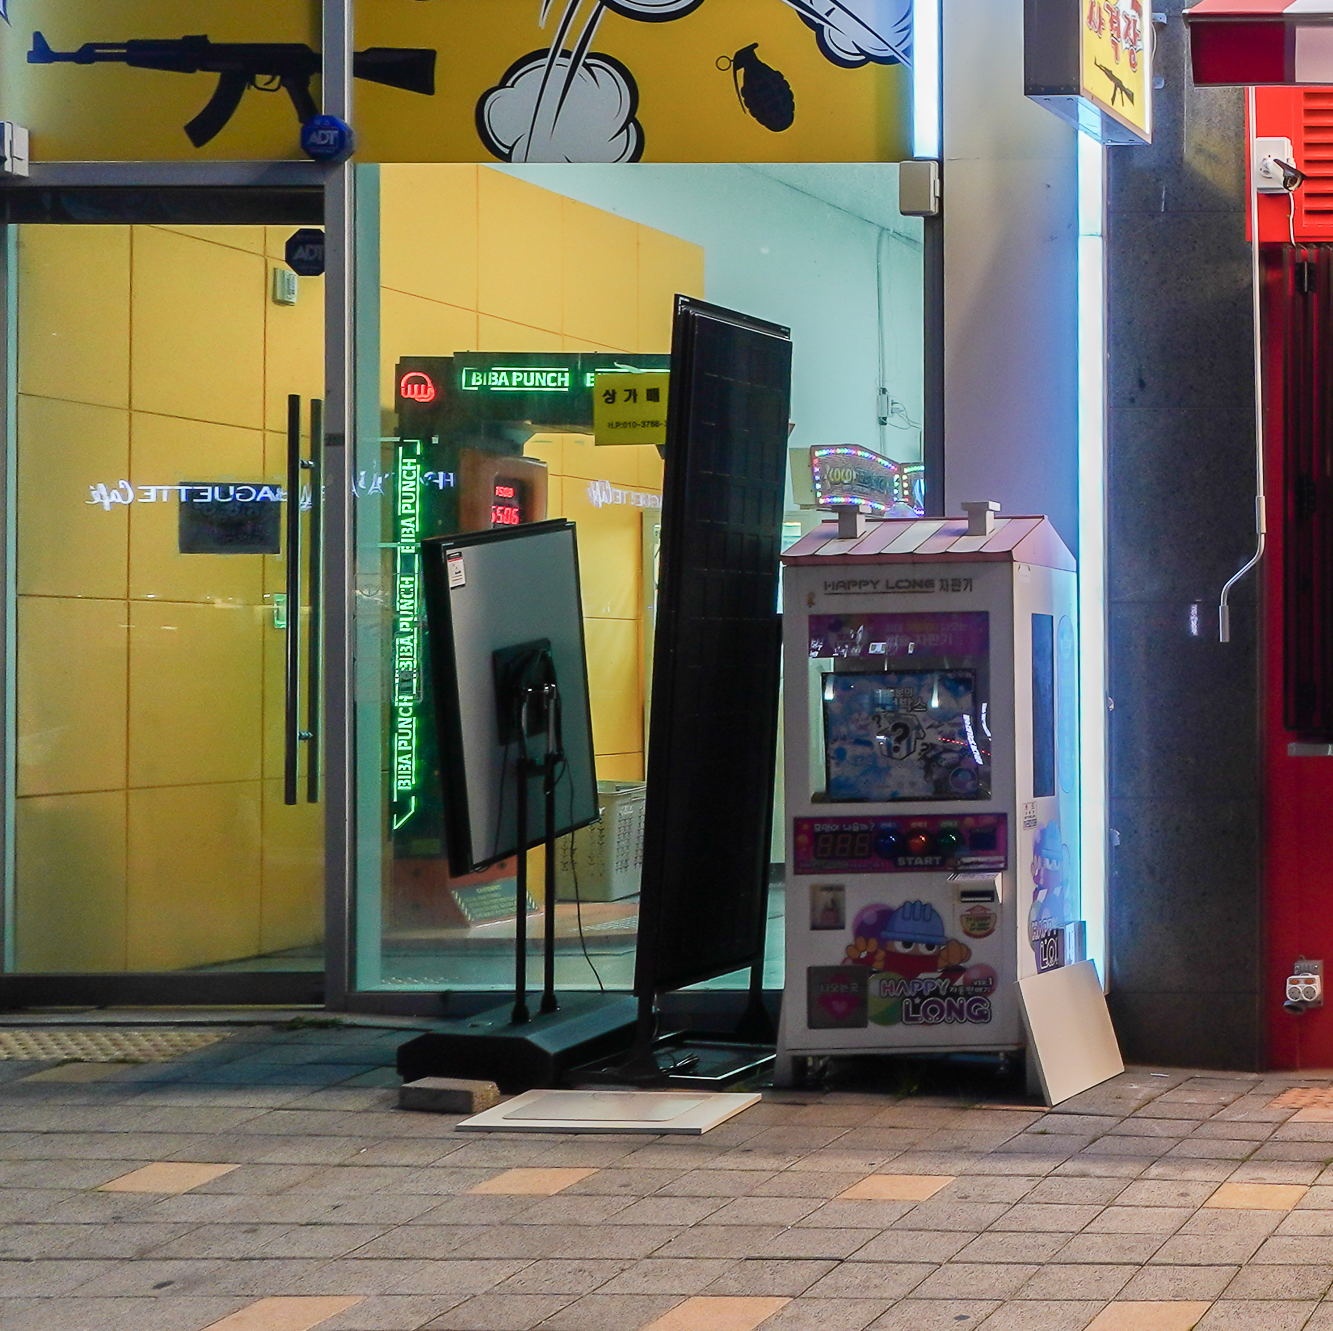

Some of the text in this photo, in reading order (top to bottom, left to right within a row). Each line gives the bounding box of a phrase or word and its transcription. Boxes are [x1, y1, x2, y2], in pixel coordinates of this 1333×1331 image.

[306, 129, 340, 146] ADT
[471, 371, 510, 387] BIBA
[512, 372, 570, 387] PUNCH
[400, 458, 417, 515] PUNCH
[824, 578, 880, 591] HAPPY
[885, 578, 935, 590] LONG
[398, 695, 414, 751] PUNCH
[397, 754, 412, 790] BIBA
[897, 856, 942, 867] START
[880, 977, 950, 998] HAPPY
[902, 996, 992, 1025] LONG
